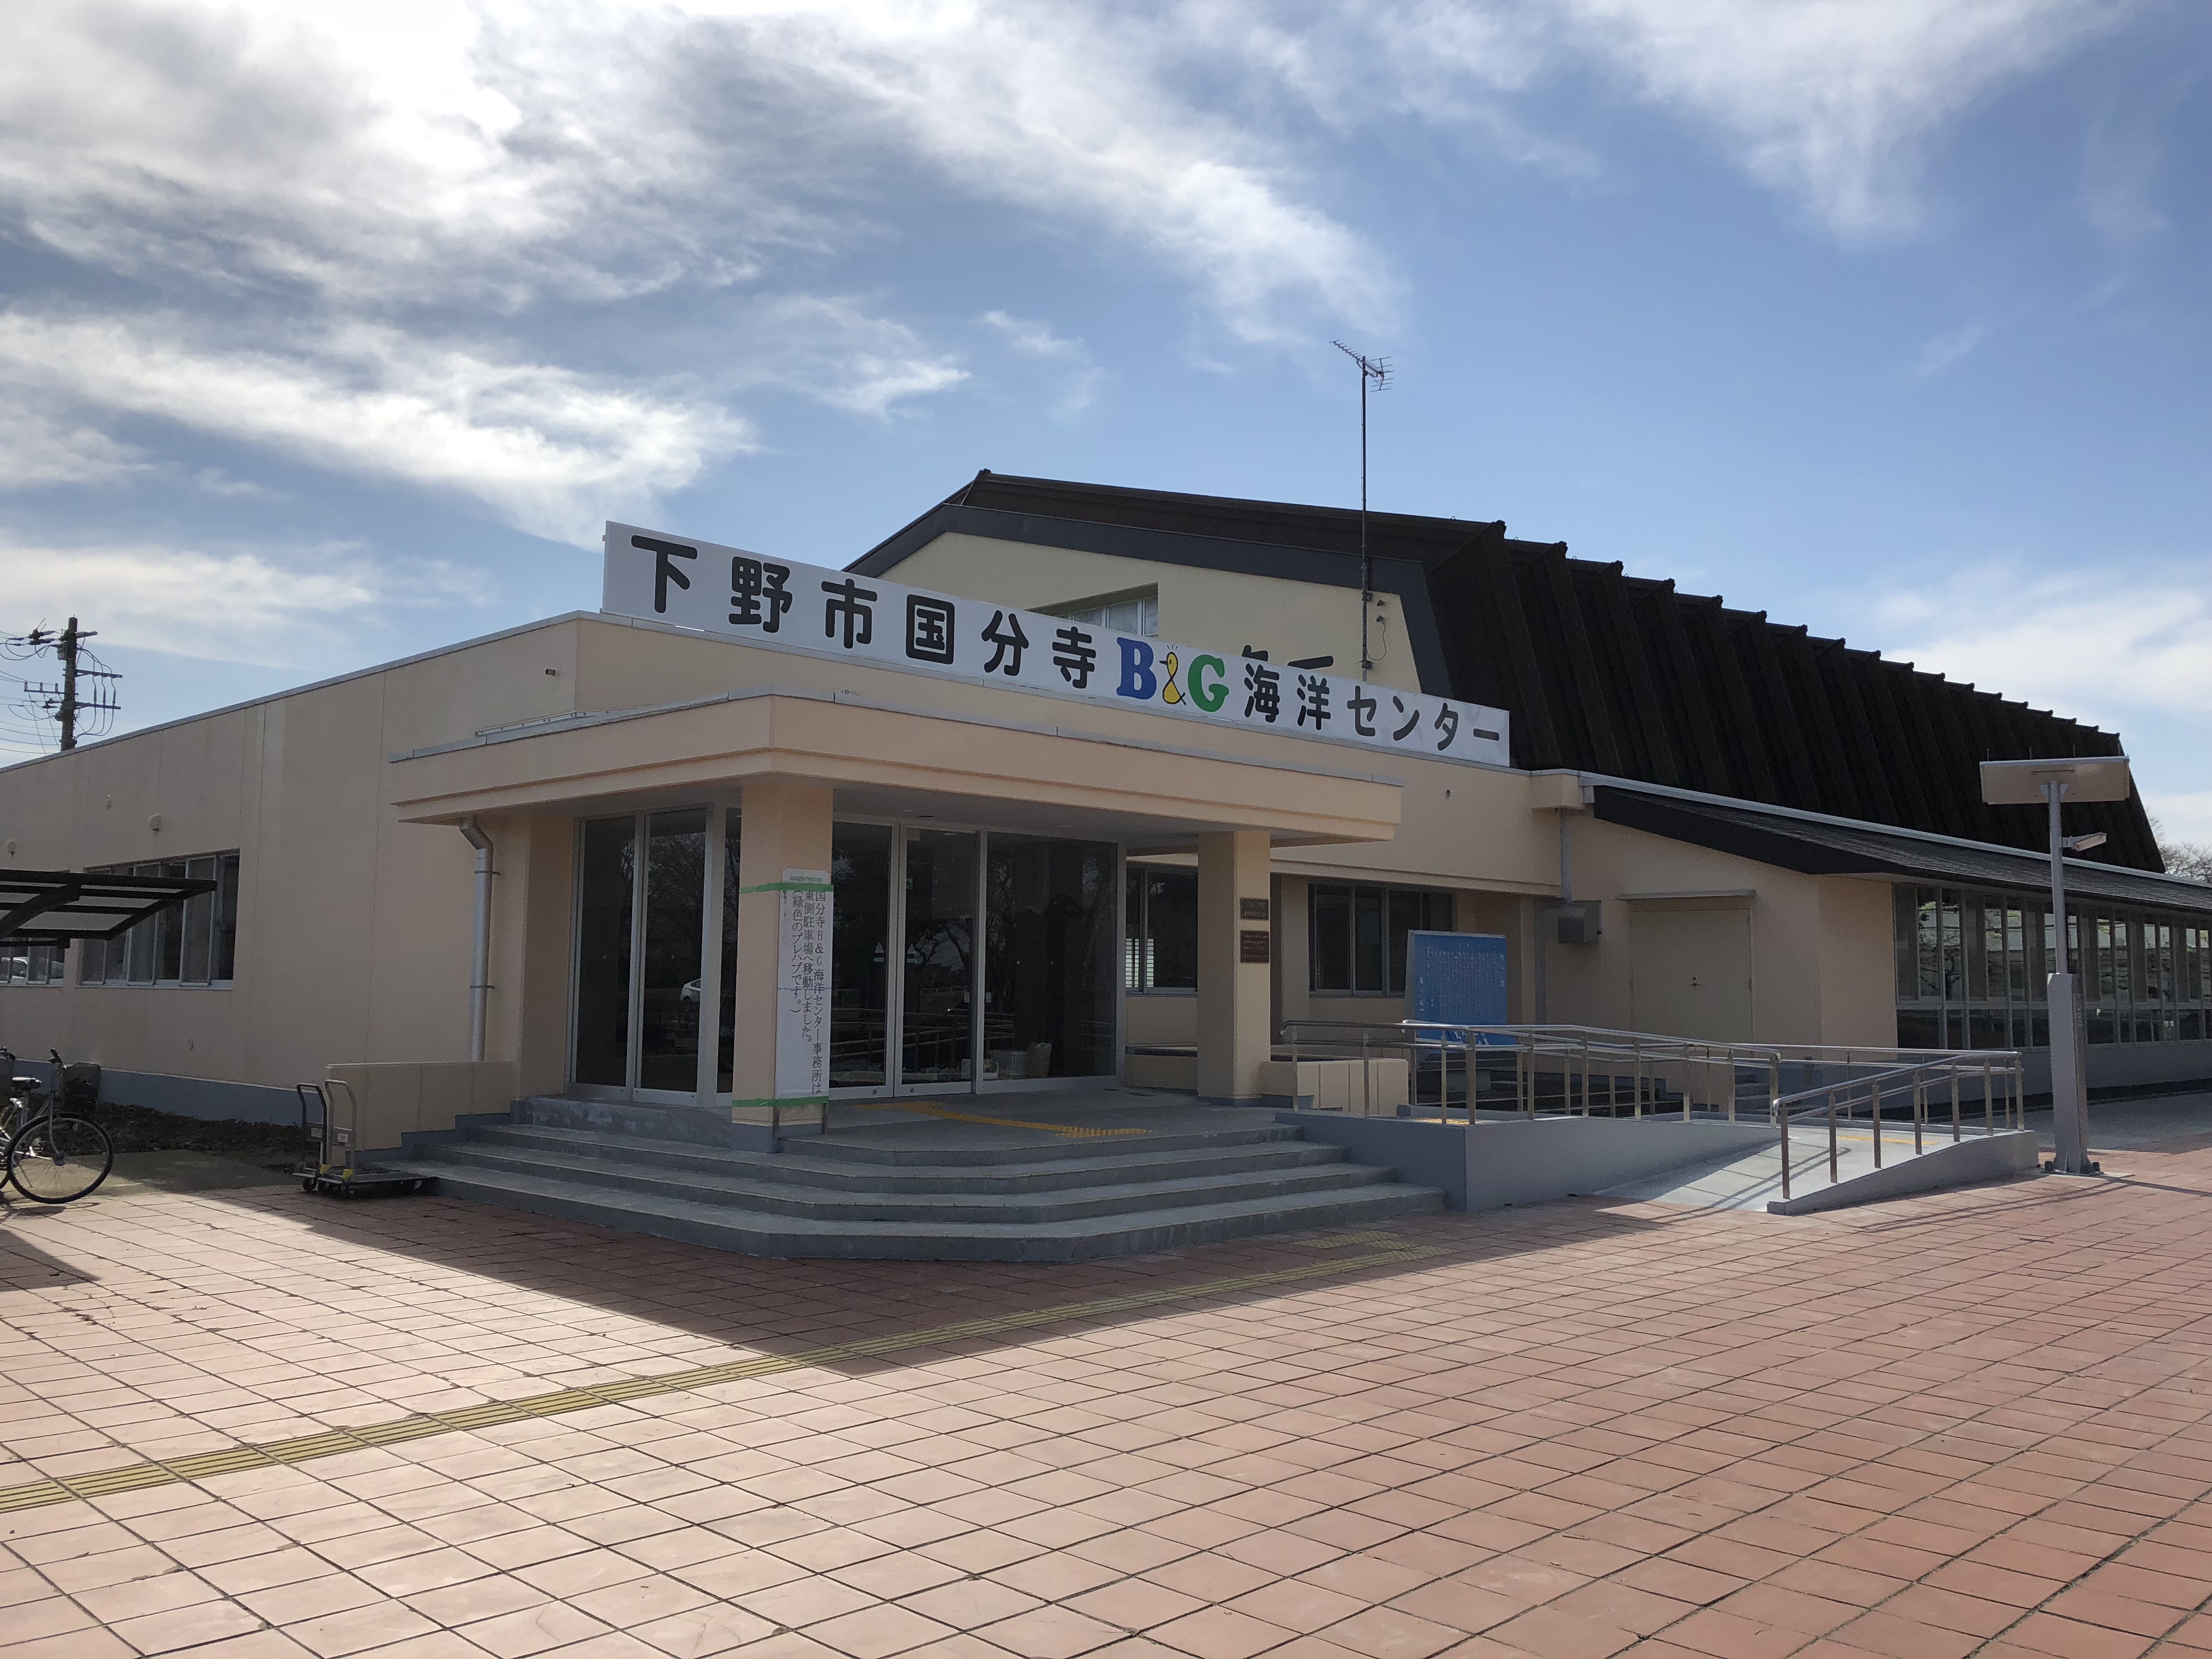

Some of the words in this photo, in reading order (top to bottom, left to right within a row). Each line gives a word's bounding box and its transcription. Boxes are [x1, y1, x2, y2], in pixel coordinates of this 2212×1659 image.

[802, 890, 815, 1042] 東側駐車場へ移動しました。
[811, 891, 826, 1094] 国分寺B&G海洋センター事務所は
